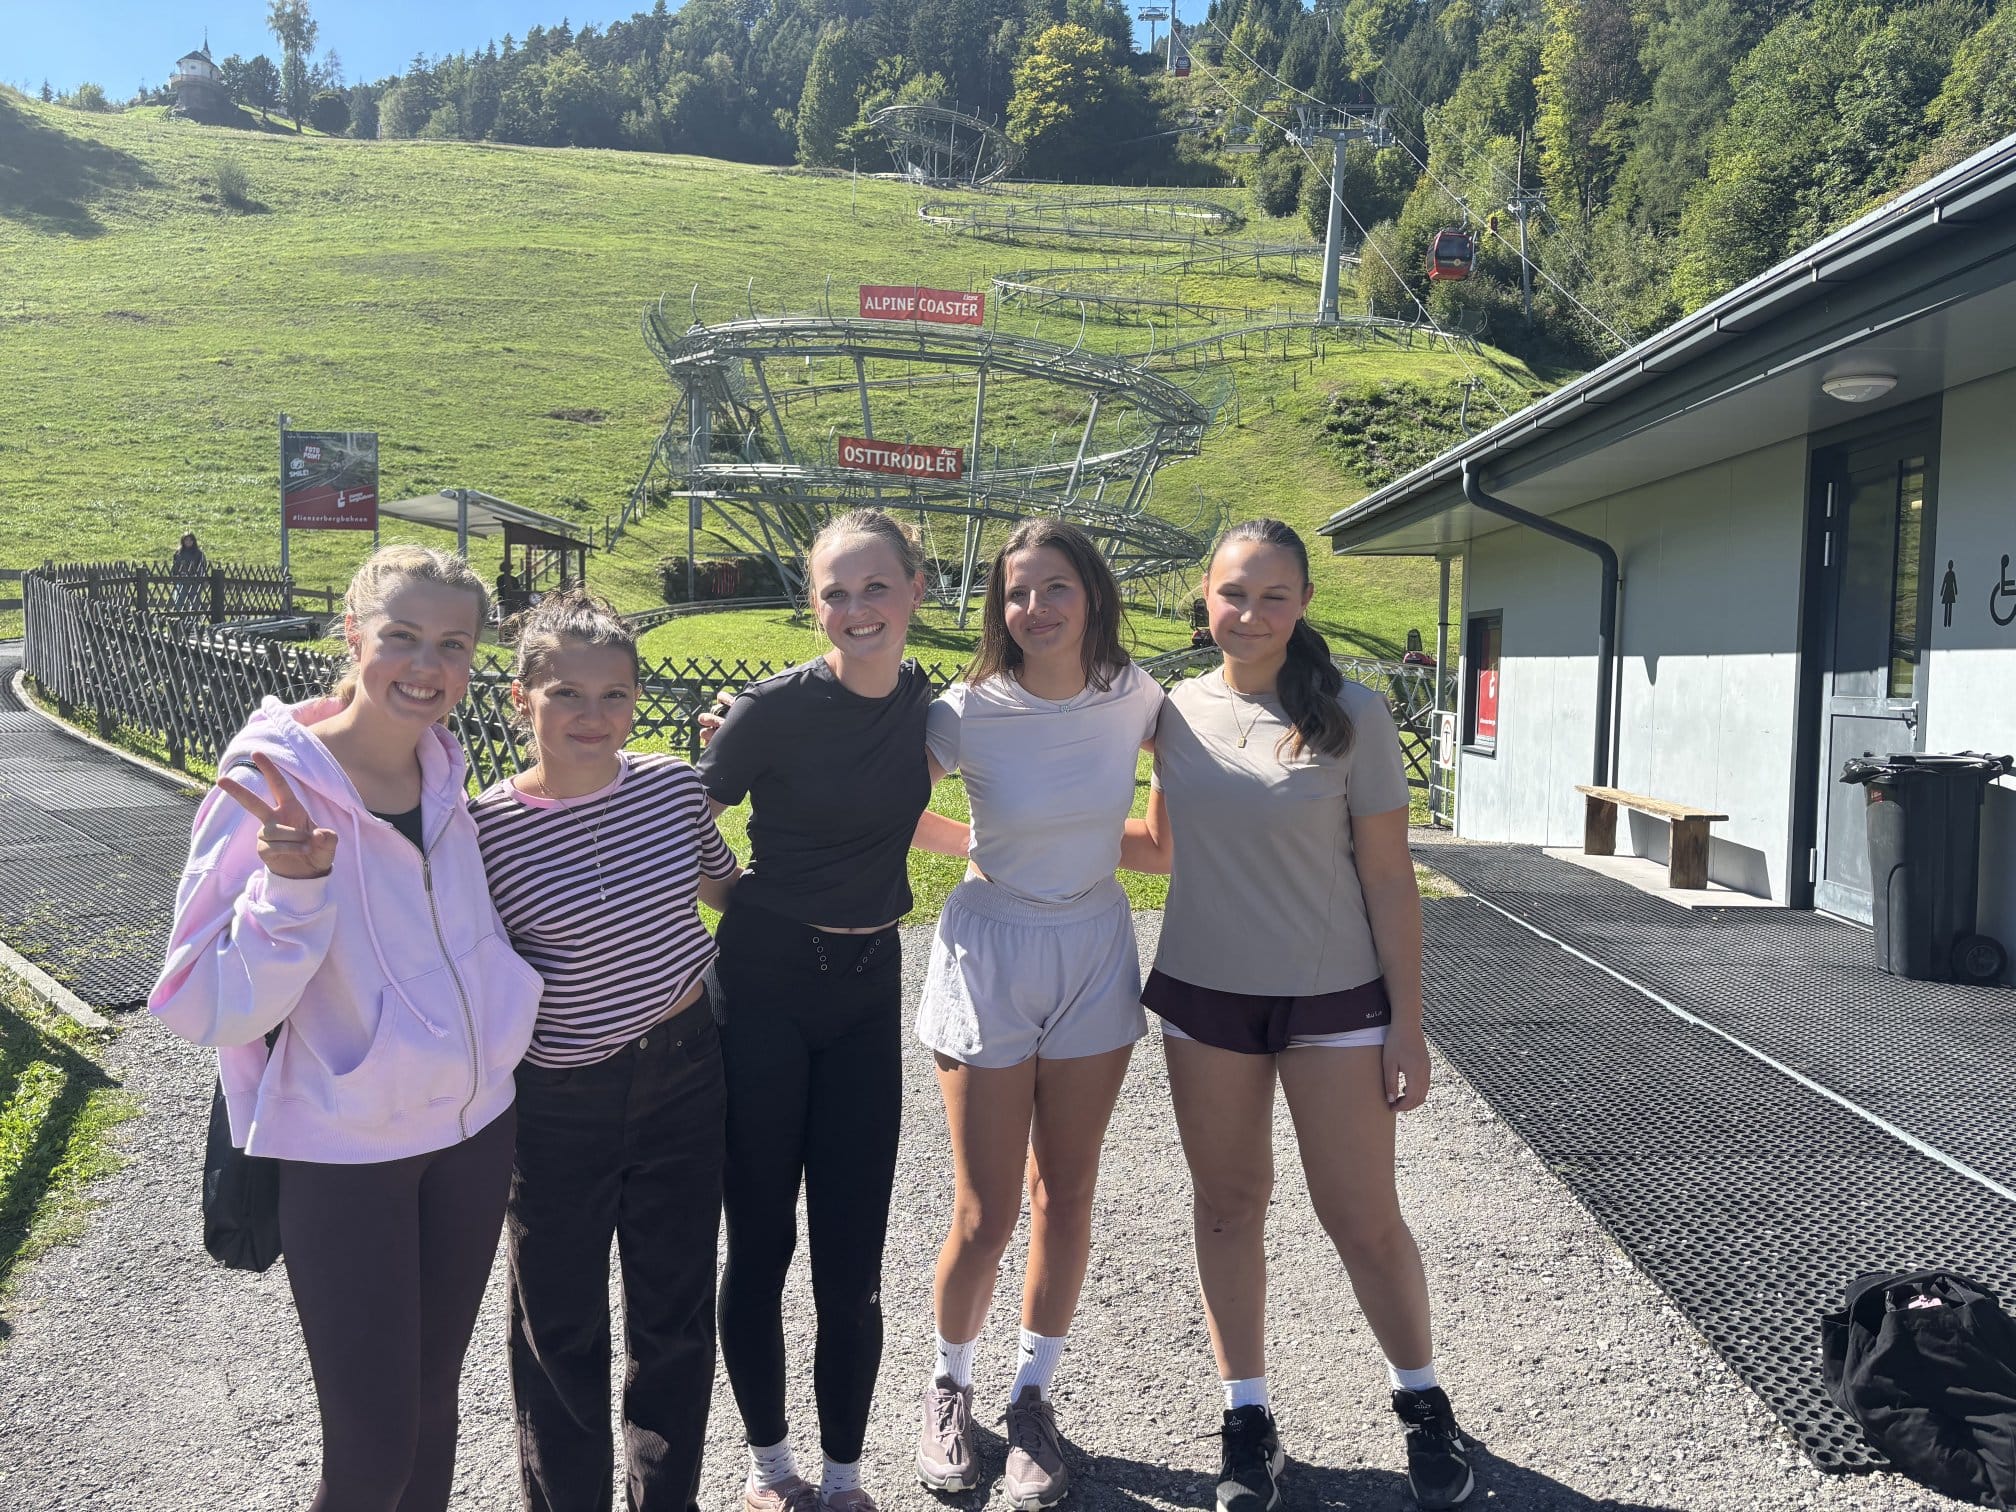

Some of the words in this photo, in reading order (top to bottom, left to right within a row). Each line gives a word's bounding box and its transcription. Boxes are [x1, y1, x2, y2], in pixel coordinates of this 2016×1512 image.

[865, 297, 914, 311] ALPINE
[919, 298, 978, 317] COASTER
[845, 445, 956, 473] OSTTIRODLER
